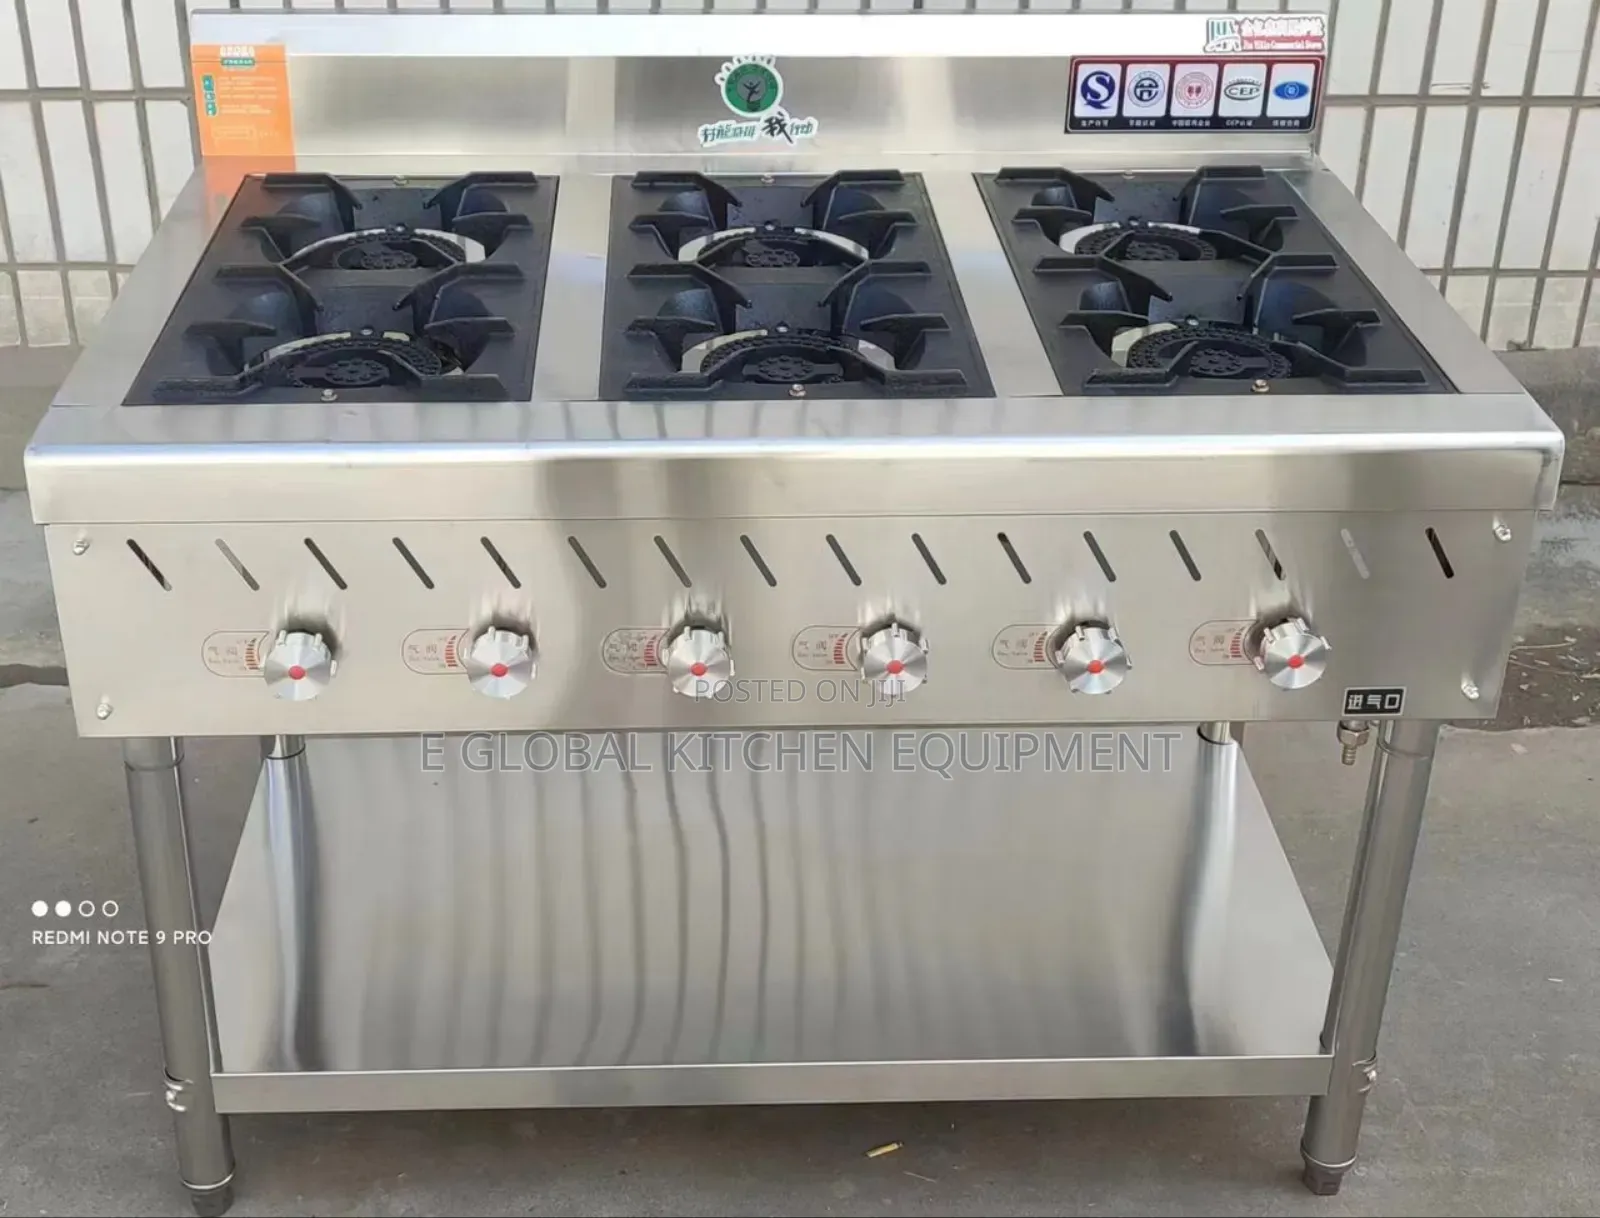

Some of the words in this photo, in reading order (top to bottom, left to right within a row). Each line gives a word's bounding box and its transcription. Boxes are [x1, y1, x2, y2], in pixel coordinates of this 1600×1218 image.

[1228, 86, 1260, 97] CEP
[1347, 694, 1401, 710] 进气口
